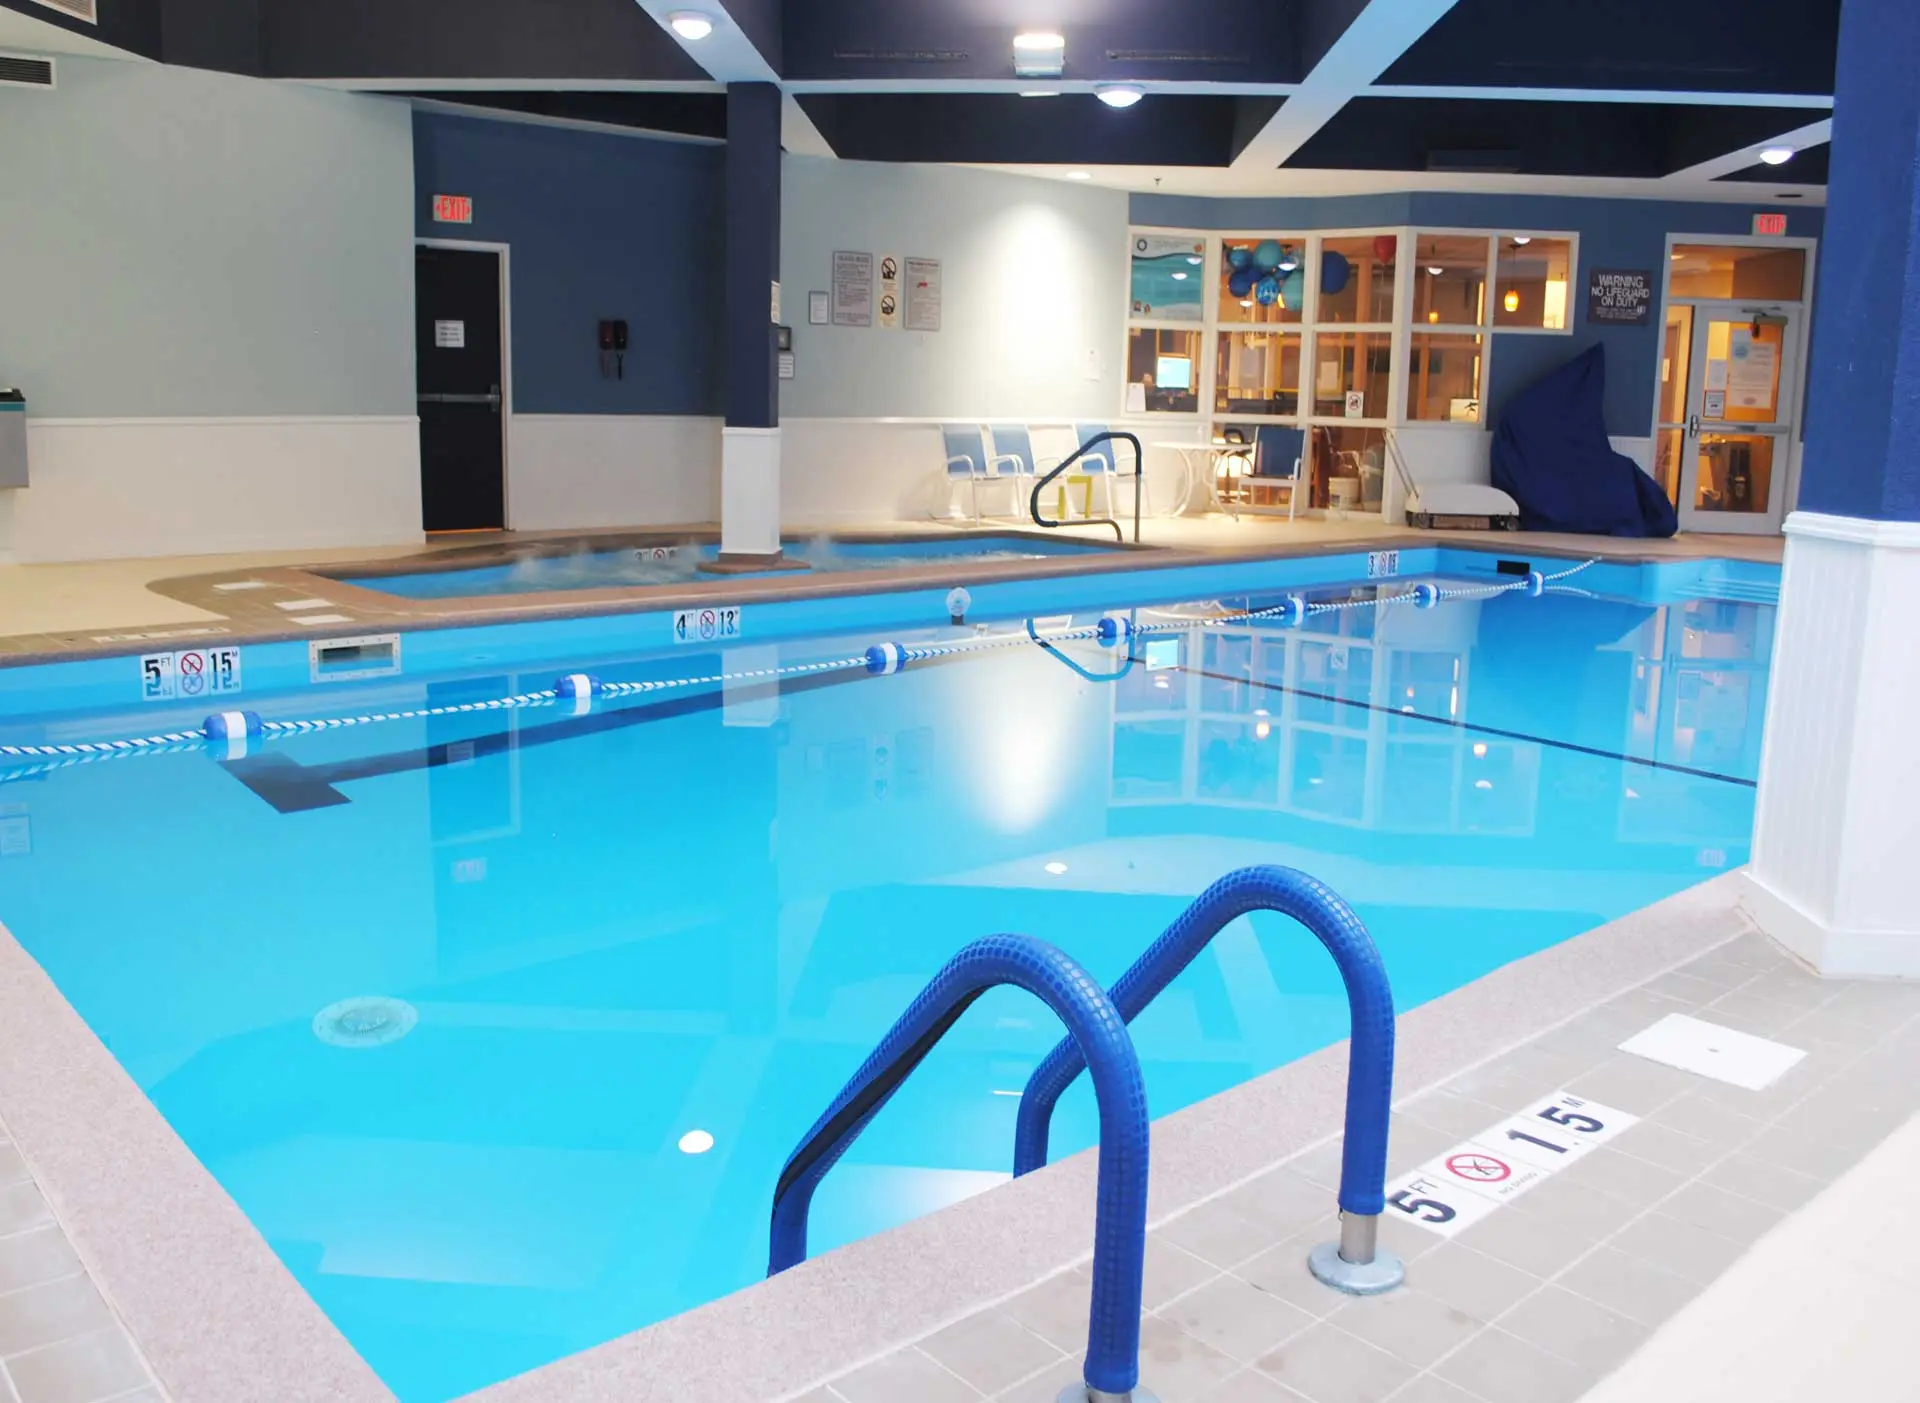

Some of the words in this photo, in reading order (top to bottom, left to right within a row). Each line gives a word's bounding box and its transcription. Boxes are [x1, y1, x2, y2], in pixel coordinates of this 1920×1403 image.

[440, 196, 466, 220] EXIT
[1759, 214, 1783, 233] EXIT
[1598, 274, 1644, 288] WARNING
[1592, 286, 1604, 297] NO
[1606, 287, 1650, 298] LIFEGUARD
[1600, 296, 1613, 306] ON
[1616, 297, 1638, 307] DUTY
[1387, 1190, 1456, 1224] 5
